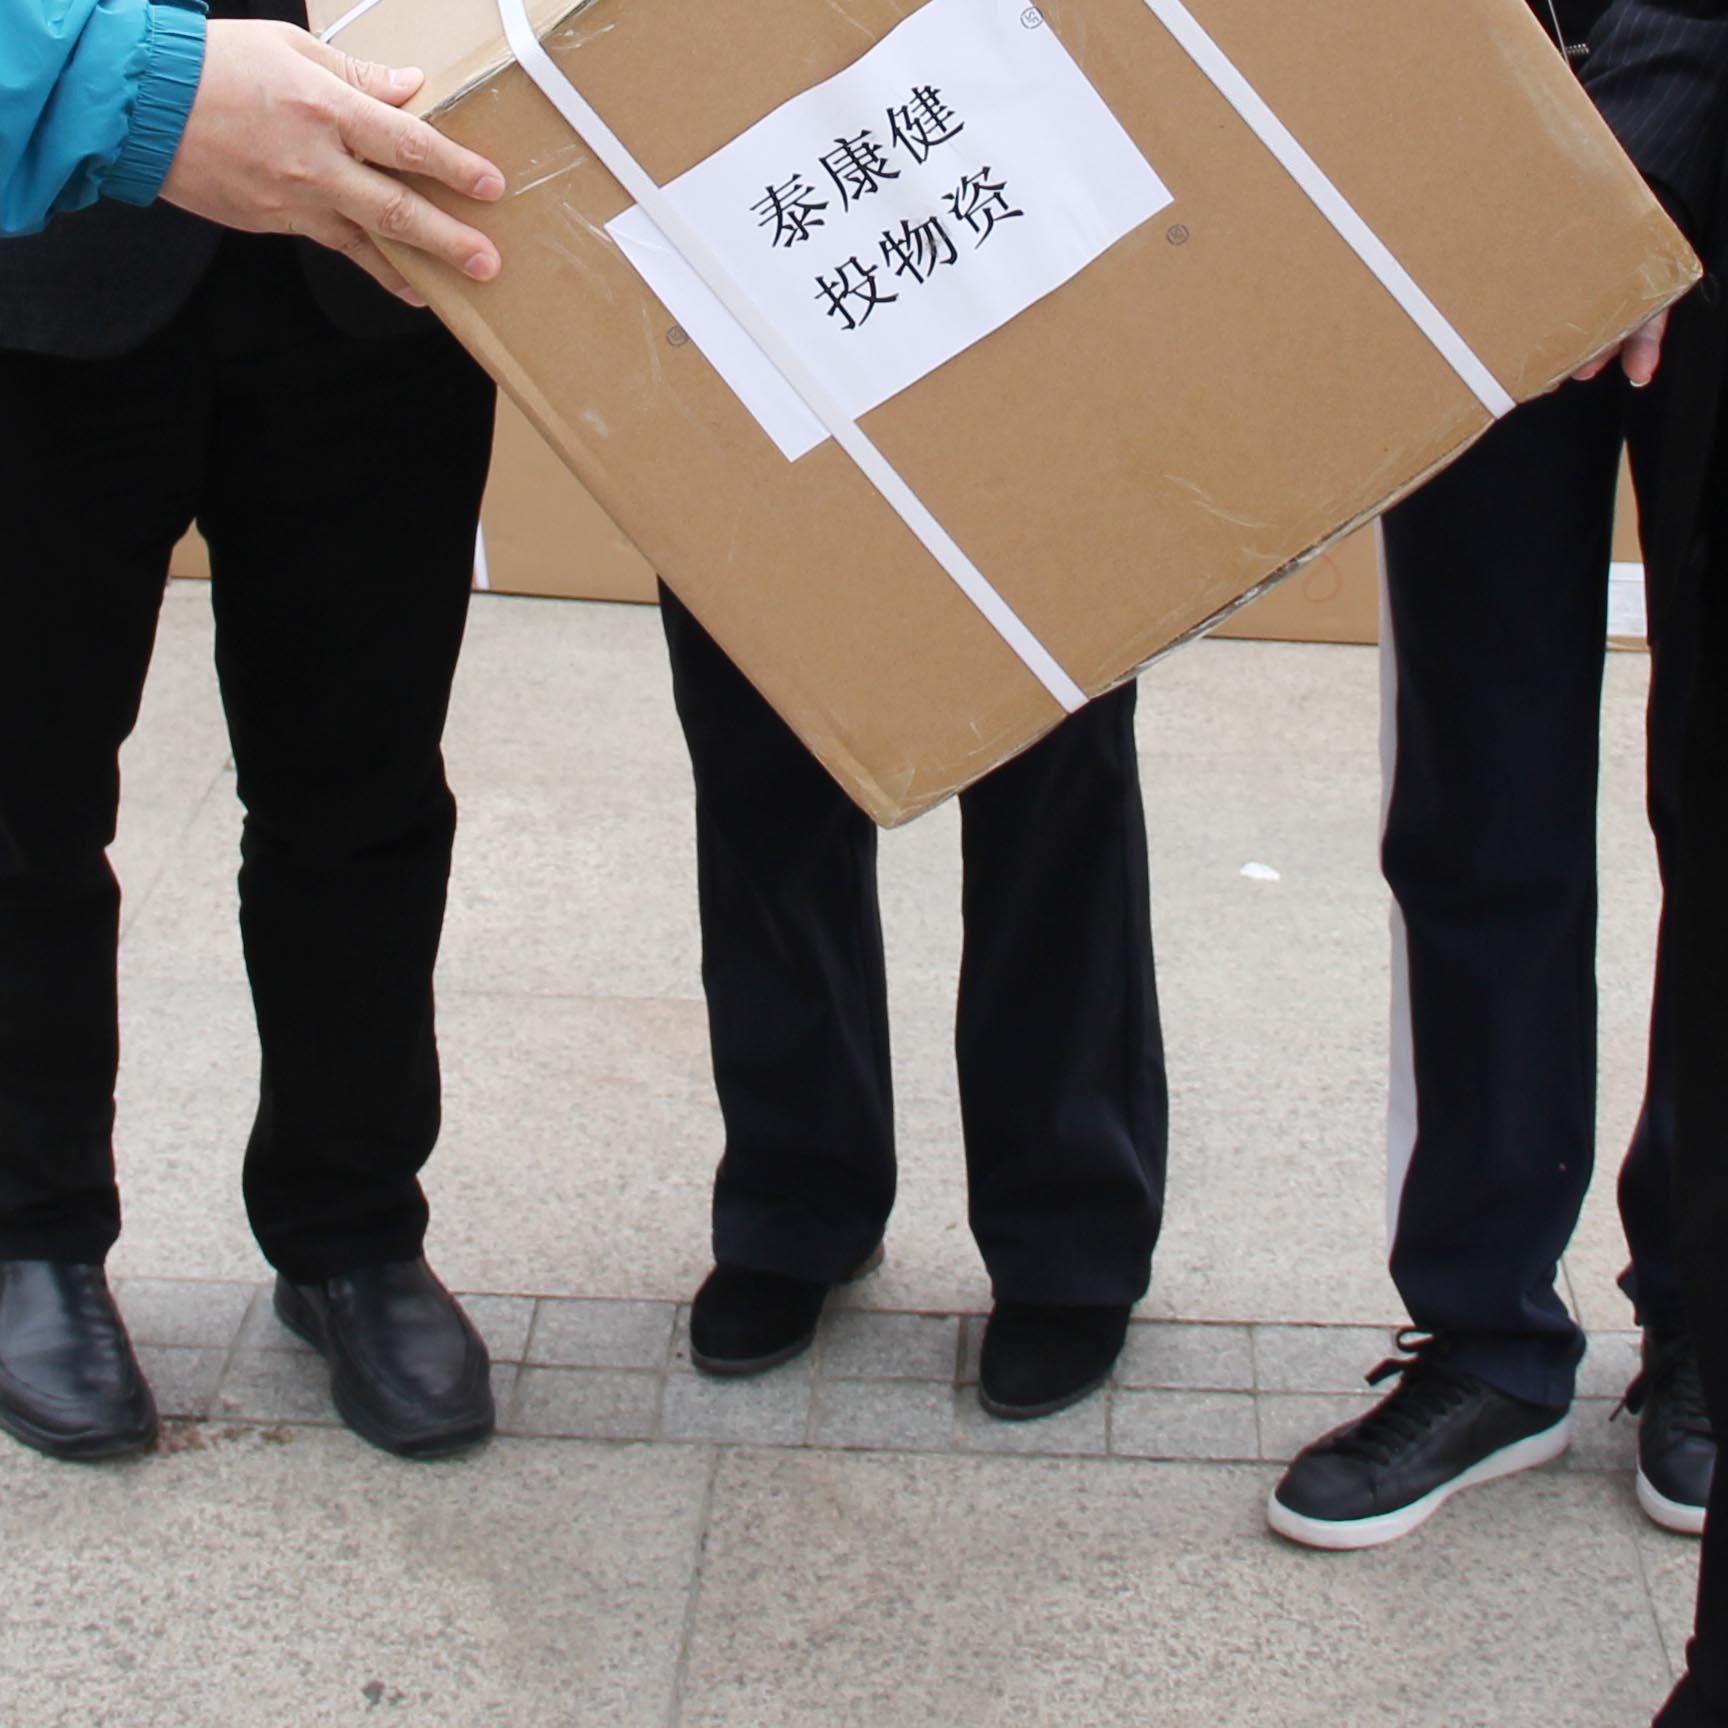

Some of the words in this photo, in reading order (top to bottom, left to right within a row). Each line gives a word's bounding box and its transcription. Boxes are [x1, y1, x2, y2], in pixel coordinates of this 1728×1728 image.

[749, 84, 965, 249] 泰康健
[813, 164, 1025, 331] 投物资
